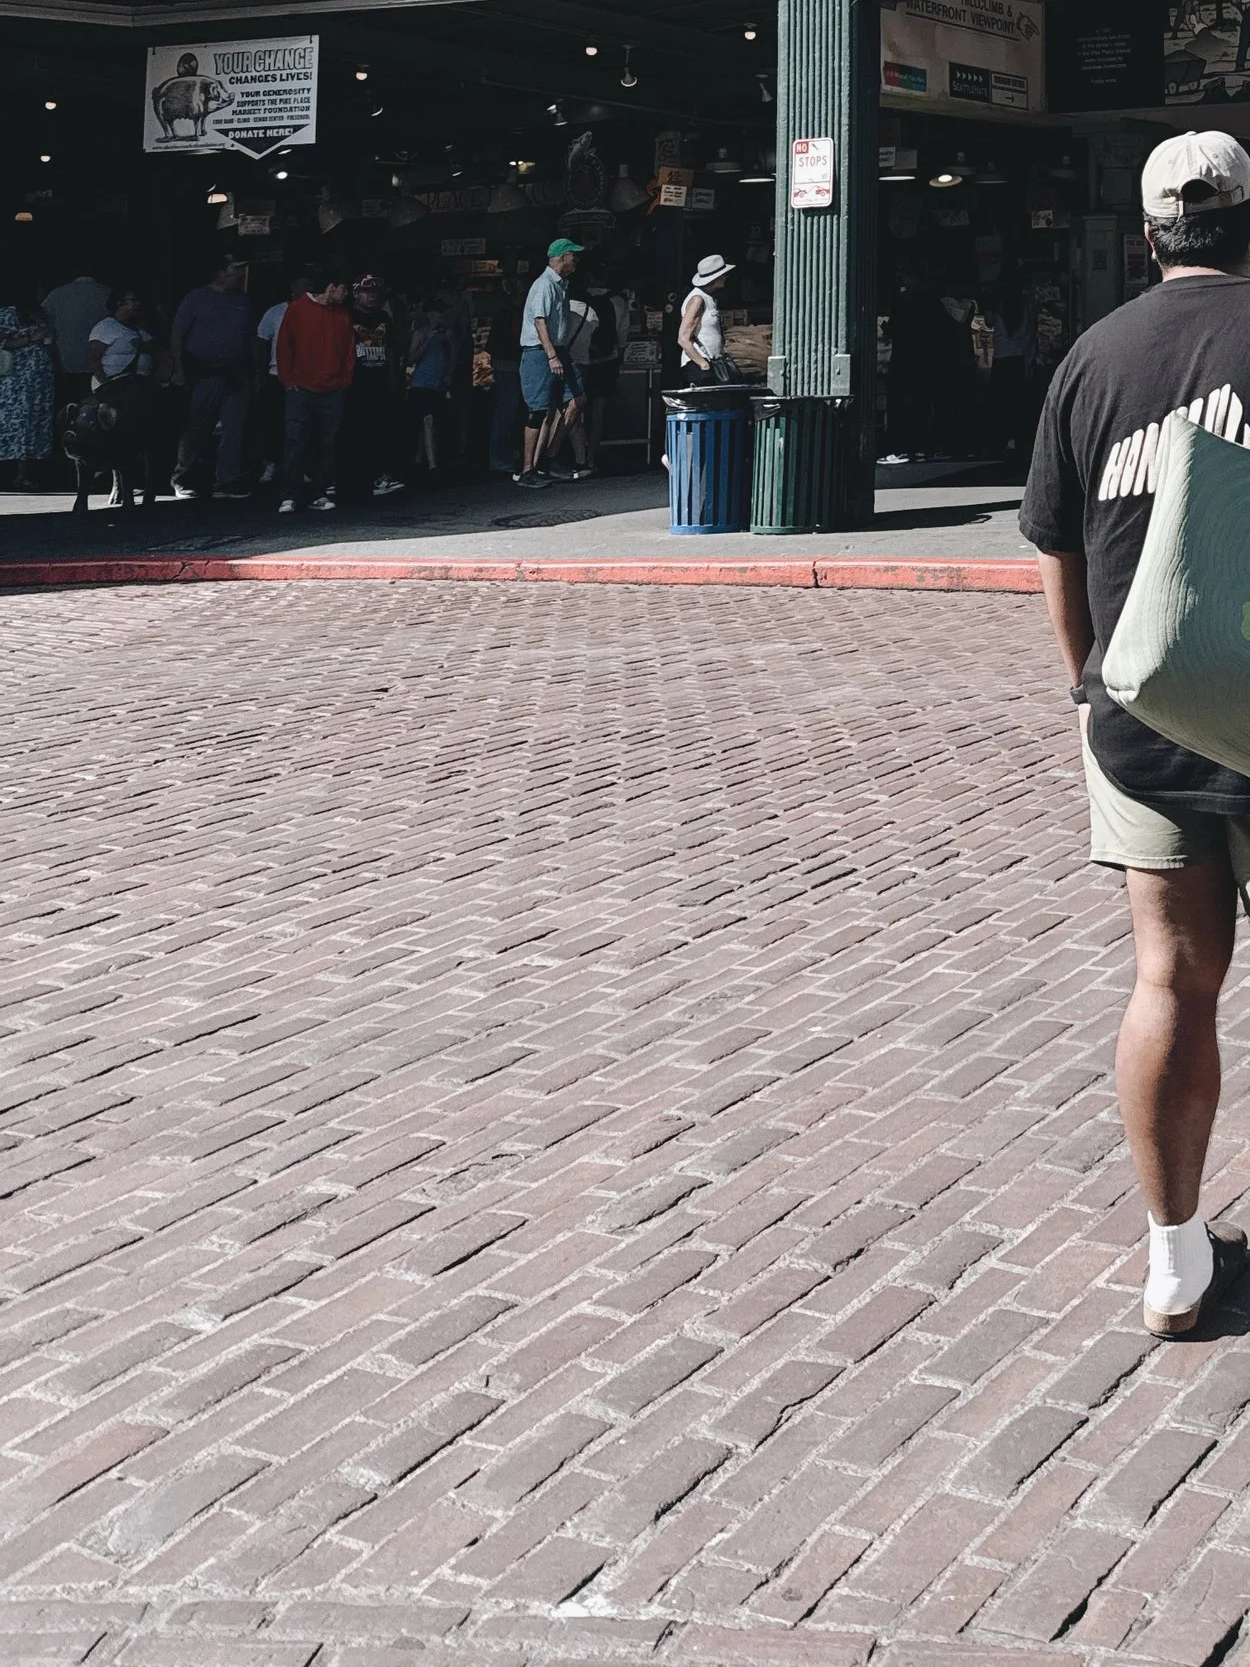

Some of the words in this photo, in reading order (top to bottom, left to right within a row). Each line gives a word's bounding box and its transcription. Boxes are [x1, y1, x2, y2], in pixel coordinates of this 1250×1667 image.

[905, 0, 967, 23] WATERFRONT
[970, 11, 1016, 34] VIEWPOINT
[1007, 5, 1013, 18] &
[213, 51, 252, 75] YOUR
[254, 47, 314, 72] CHANGE
[229, 74, 278, 85] CHANGES
[279, 72, 312, 82] LIVES!
[240, 90, 261, 98] YOUR
[263, 87, 311, 97] GENEROSITY
[228, 129, 265, 139] DONATE
[266, 128, 294, 137] HERE!
[796, 143, 808, 154] NO
[798, 155, 828, 168] STOPS
